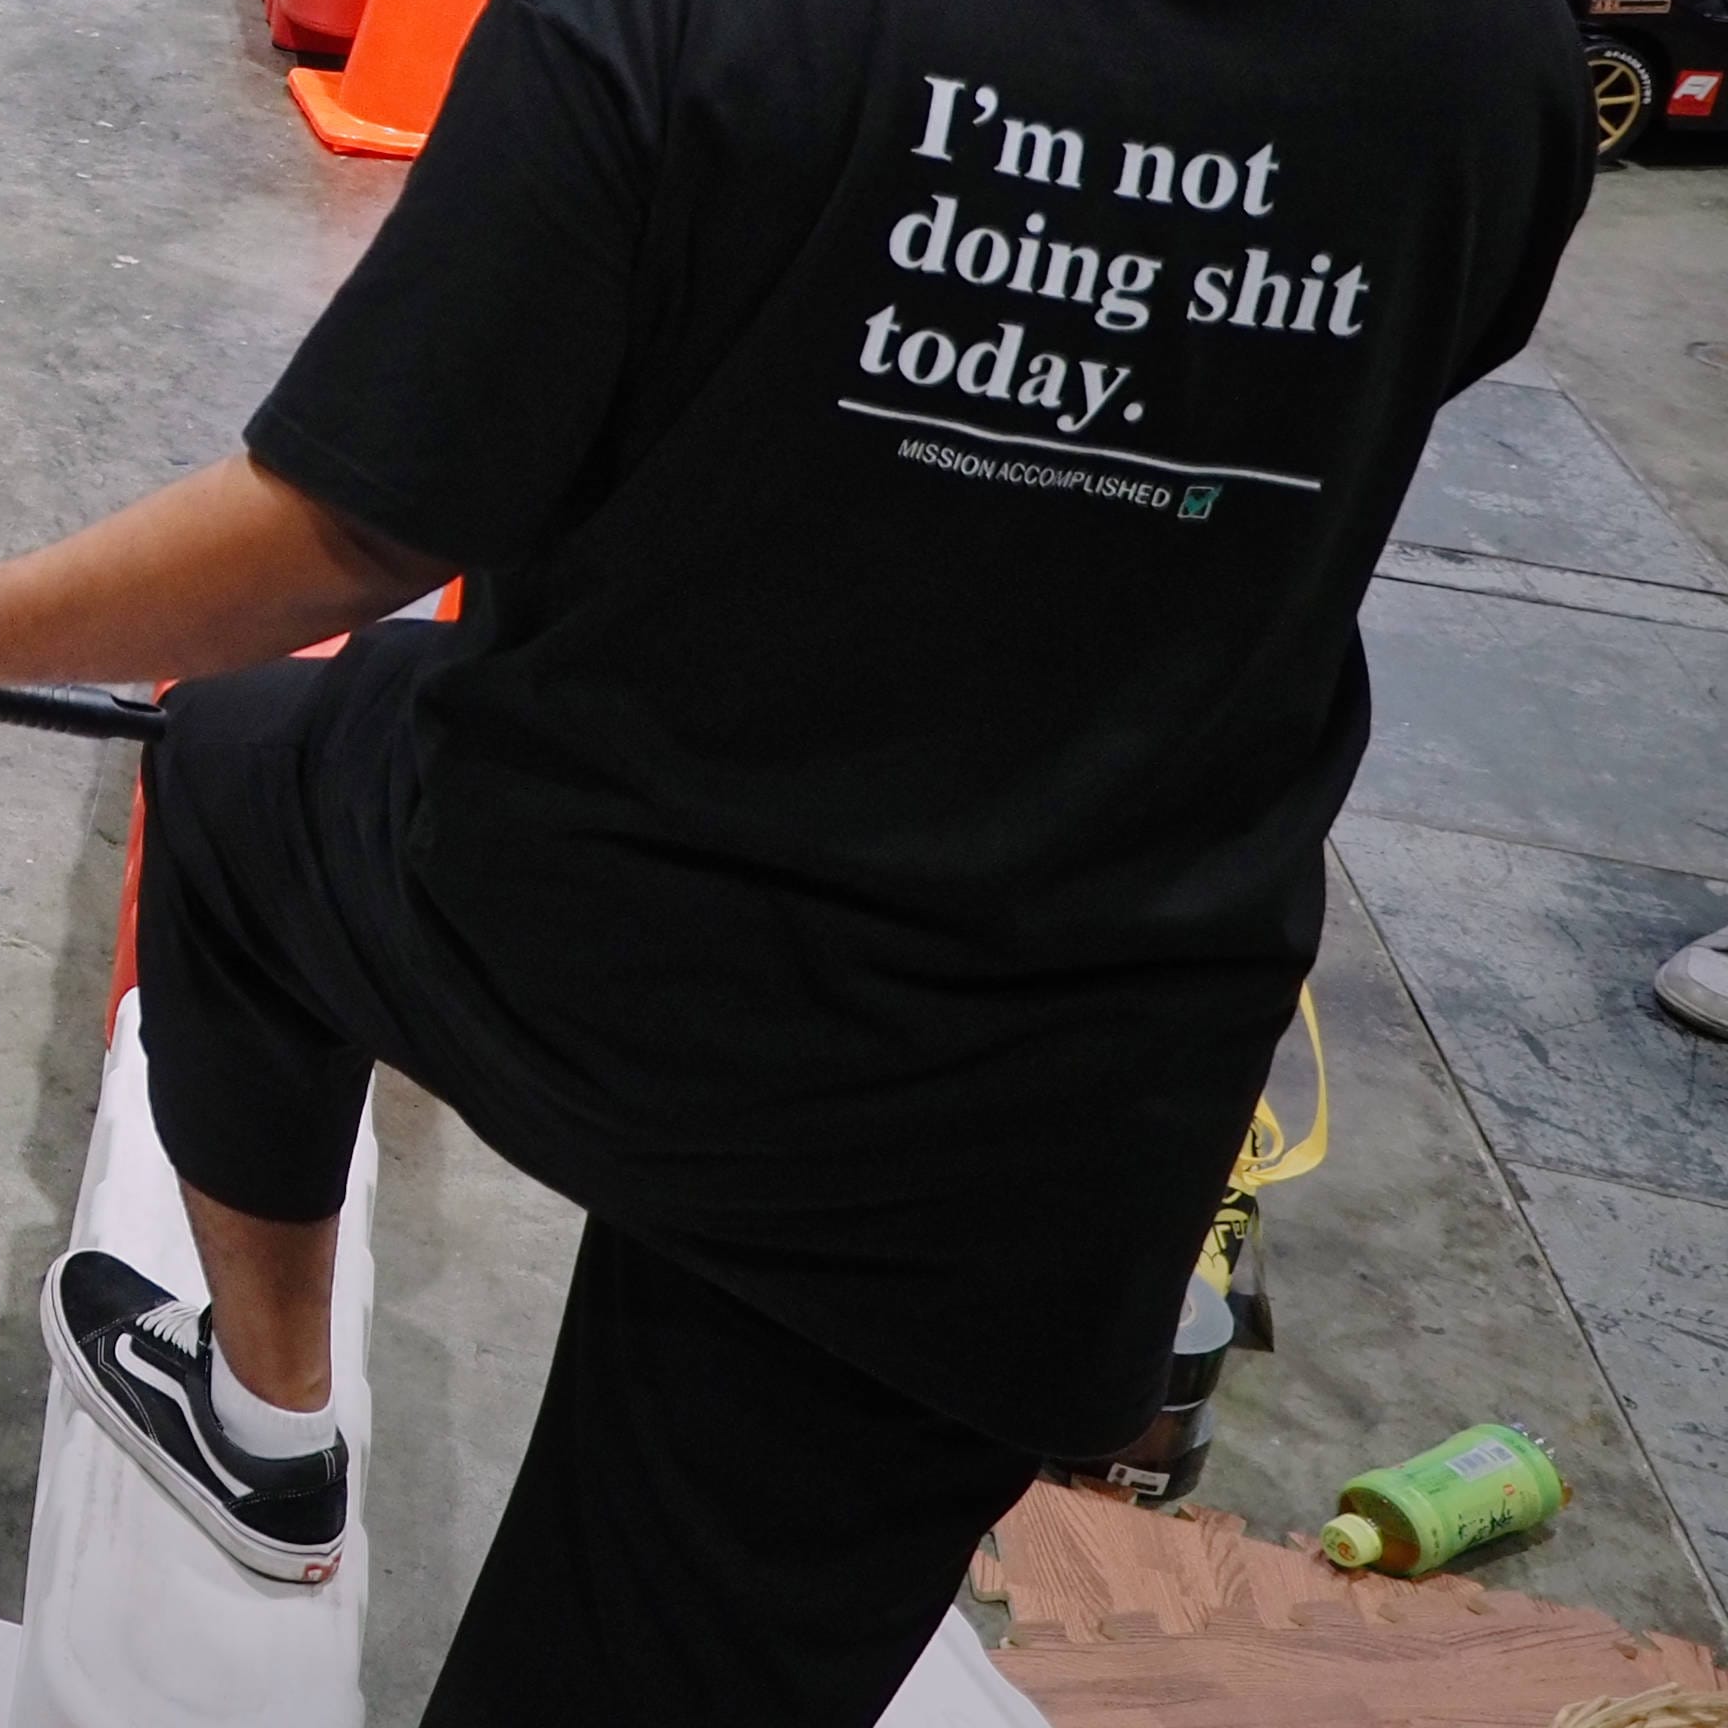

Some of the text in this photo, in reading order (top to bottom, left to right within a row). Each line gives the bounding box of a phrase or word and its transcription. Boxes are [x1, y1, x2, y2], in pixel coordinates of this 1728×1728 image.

[1112, 140, 1280, 218] not
[888, 194, 1370, 339] doing shit
[858, 303, 1144, 434] today.
[896, 438, 1172, 510] MISSION ACCOMPLISHED
